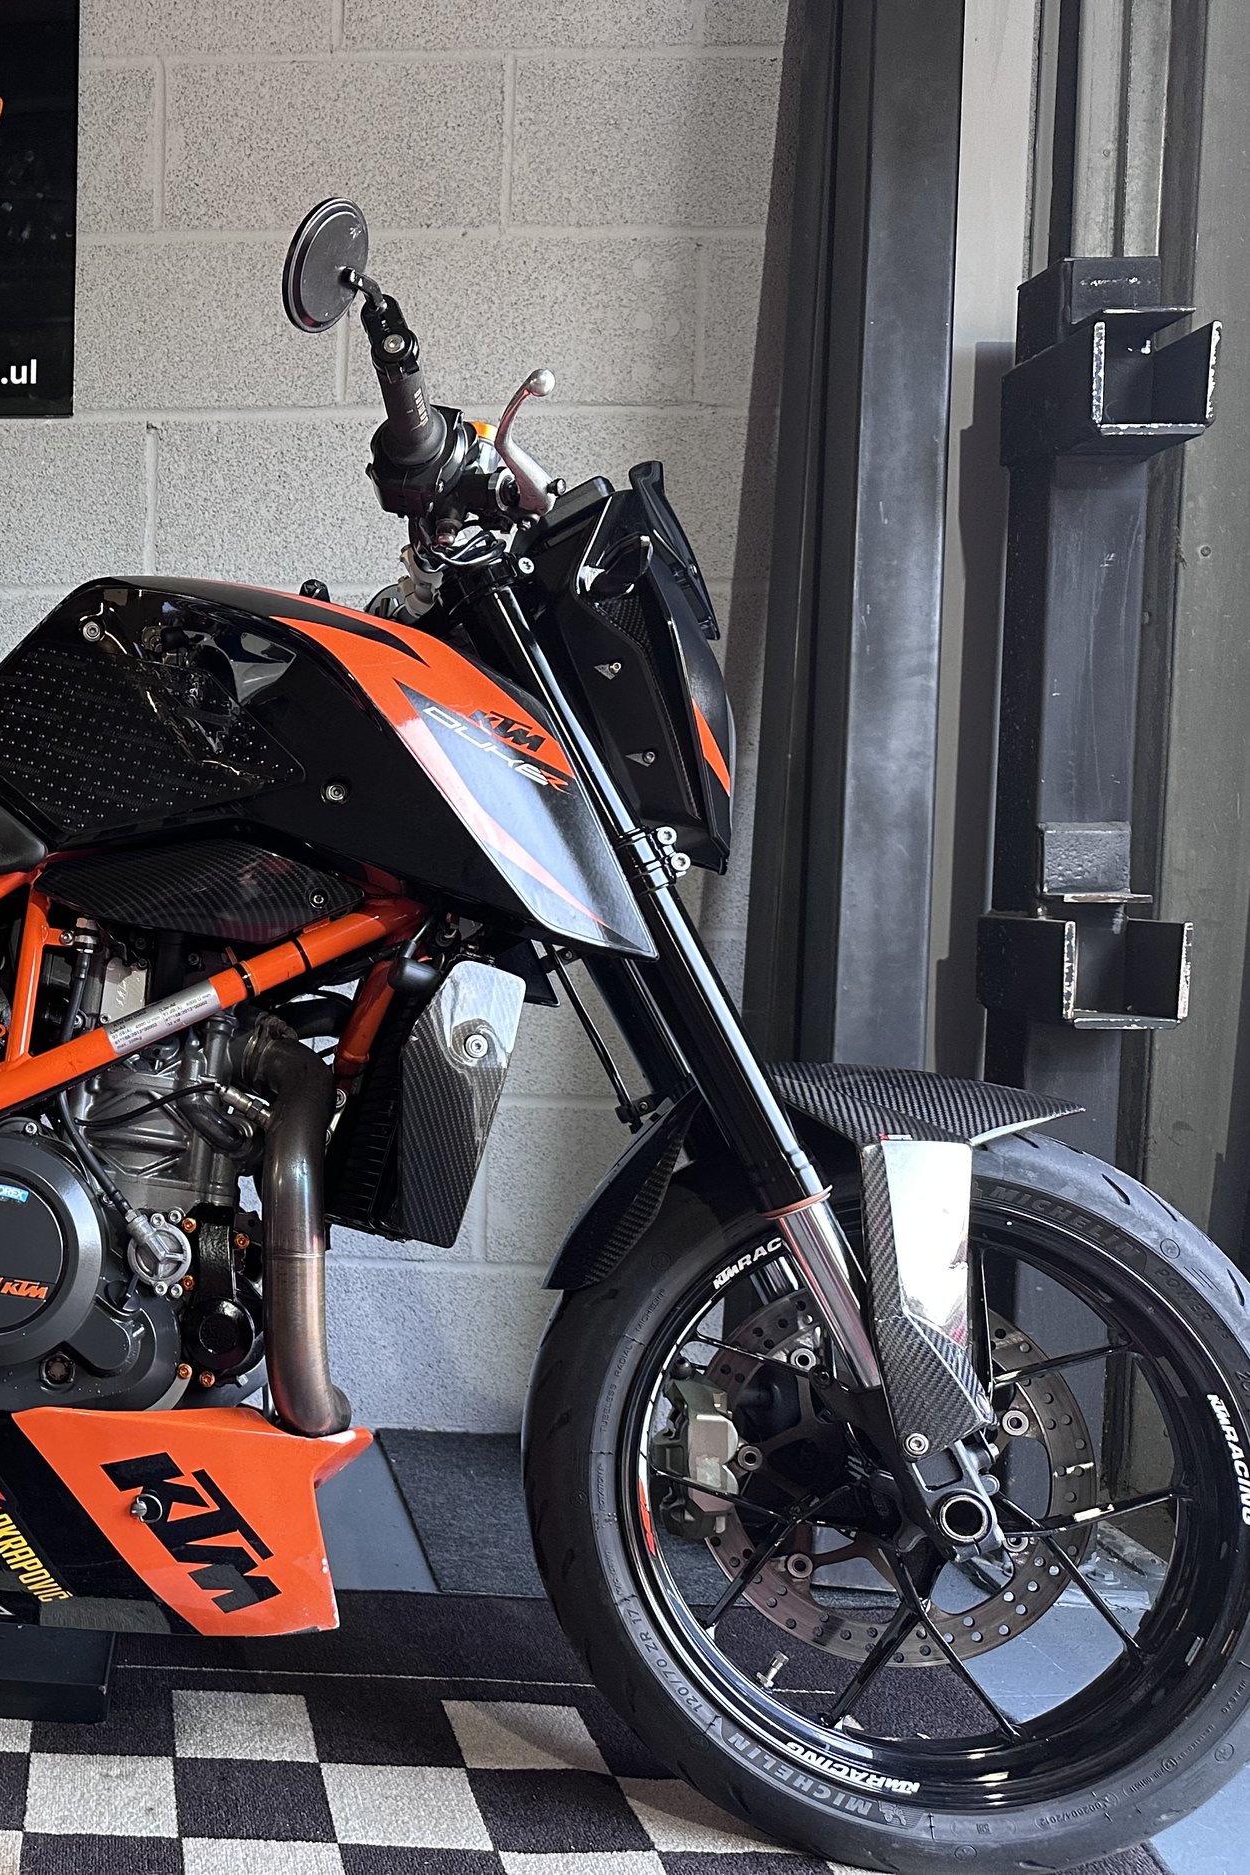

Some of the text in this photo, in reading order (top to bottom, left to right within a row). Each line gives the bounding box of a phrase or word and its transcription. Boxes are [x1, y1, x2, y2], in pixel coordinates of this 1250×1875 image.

[423, 706, 549, 786] DUKE
[469, 710, 546, 752] KTM
[0, 1280, 49, 1299] KTM
[100, 1452, 282, 1614] KTM
[626, 1608, 703, 1713] 120/70 ZR 17
[728, 1732, 872, 1817] MICHELIN
